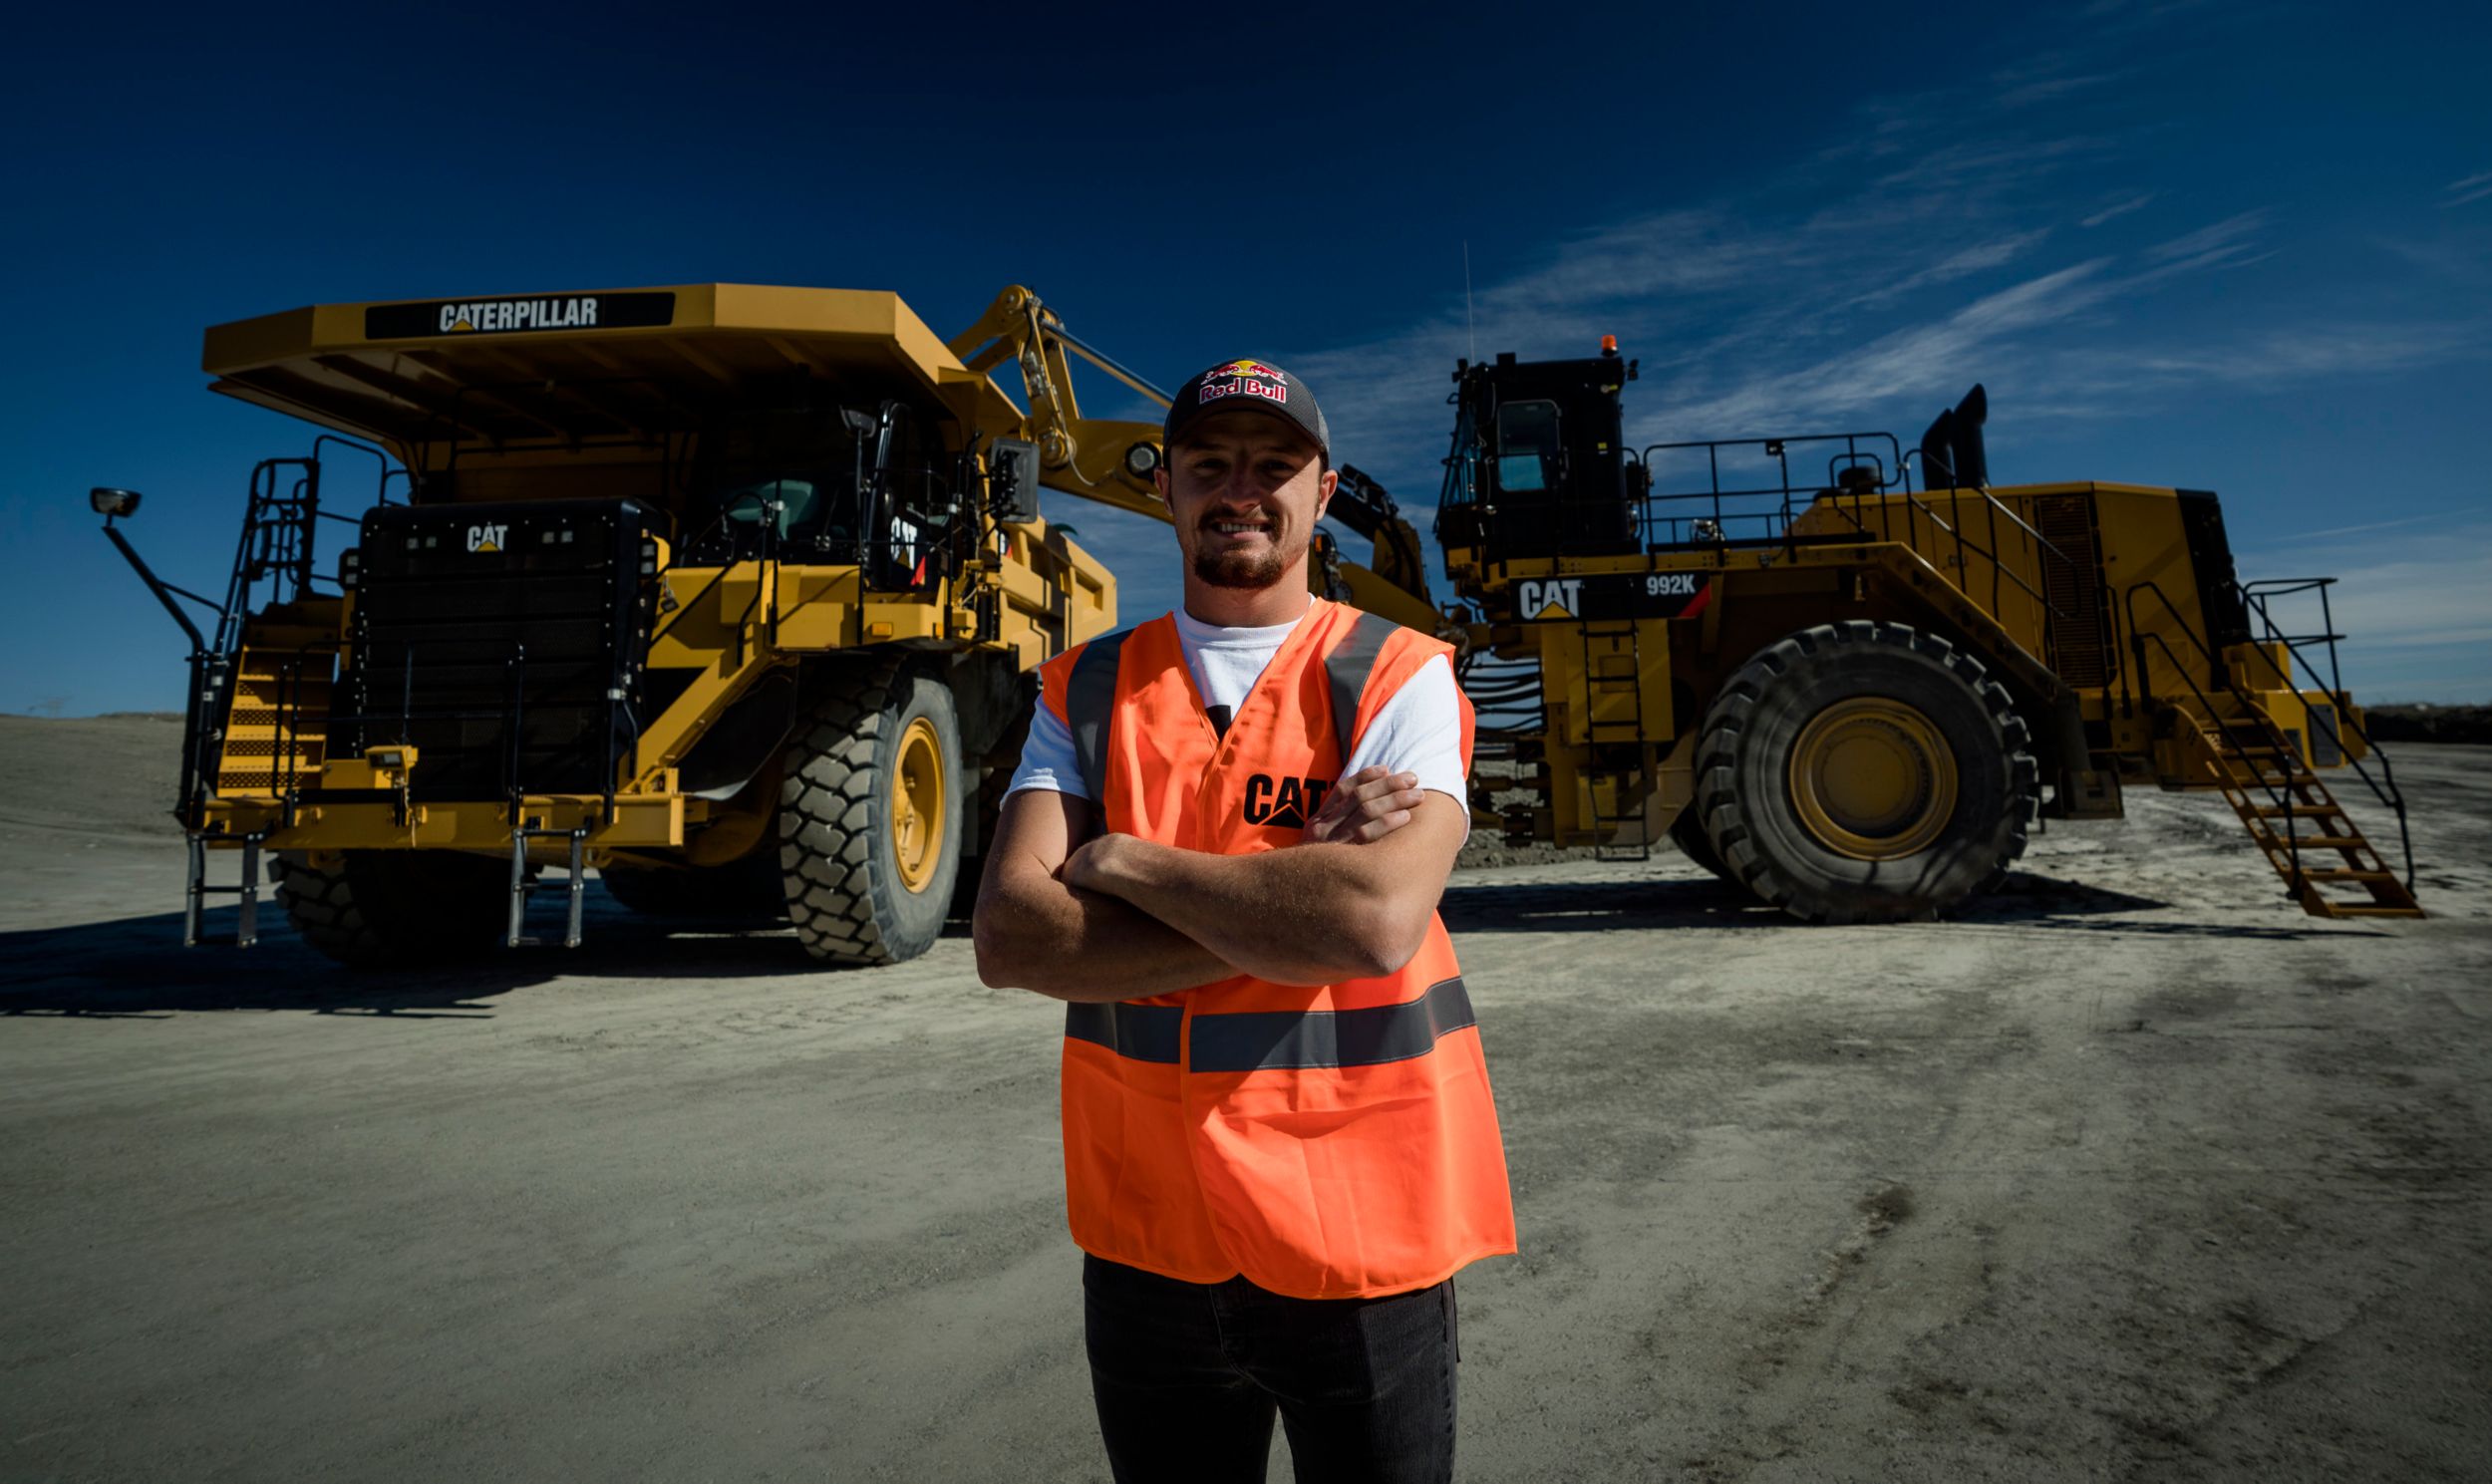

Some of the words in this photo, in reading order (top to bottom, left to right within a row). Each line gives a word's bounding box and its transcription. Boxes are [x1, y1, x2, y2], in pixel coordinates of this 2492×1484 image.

[439, 297, 598, 334] CATERPILLAR
[1199, 377, 1242, 405] Red
[1244, 378, 1287, 405] Bull
[467, 523, 509, 553] CAT
[1518, 579, 1583, 620] CAT
[1646, 574, 1696, 597] 992K
[1243, 773, 1328, 829] CAT
